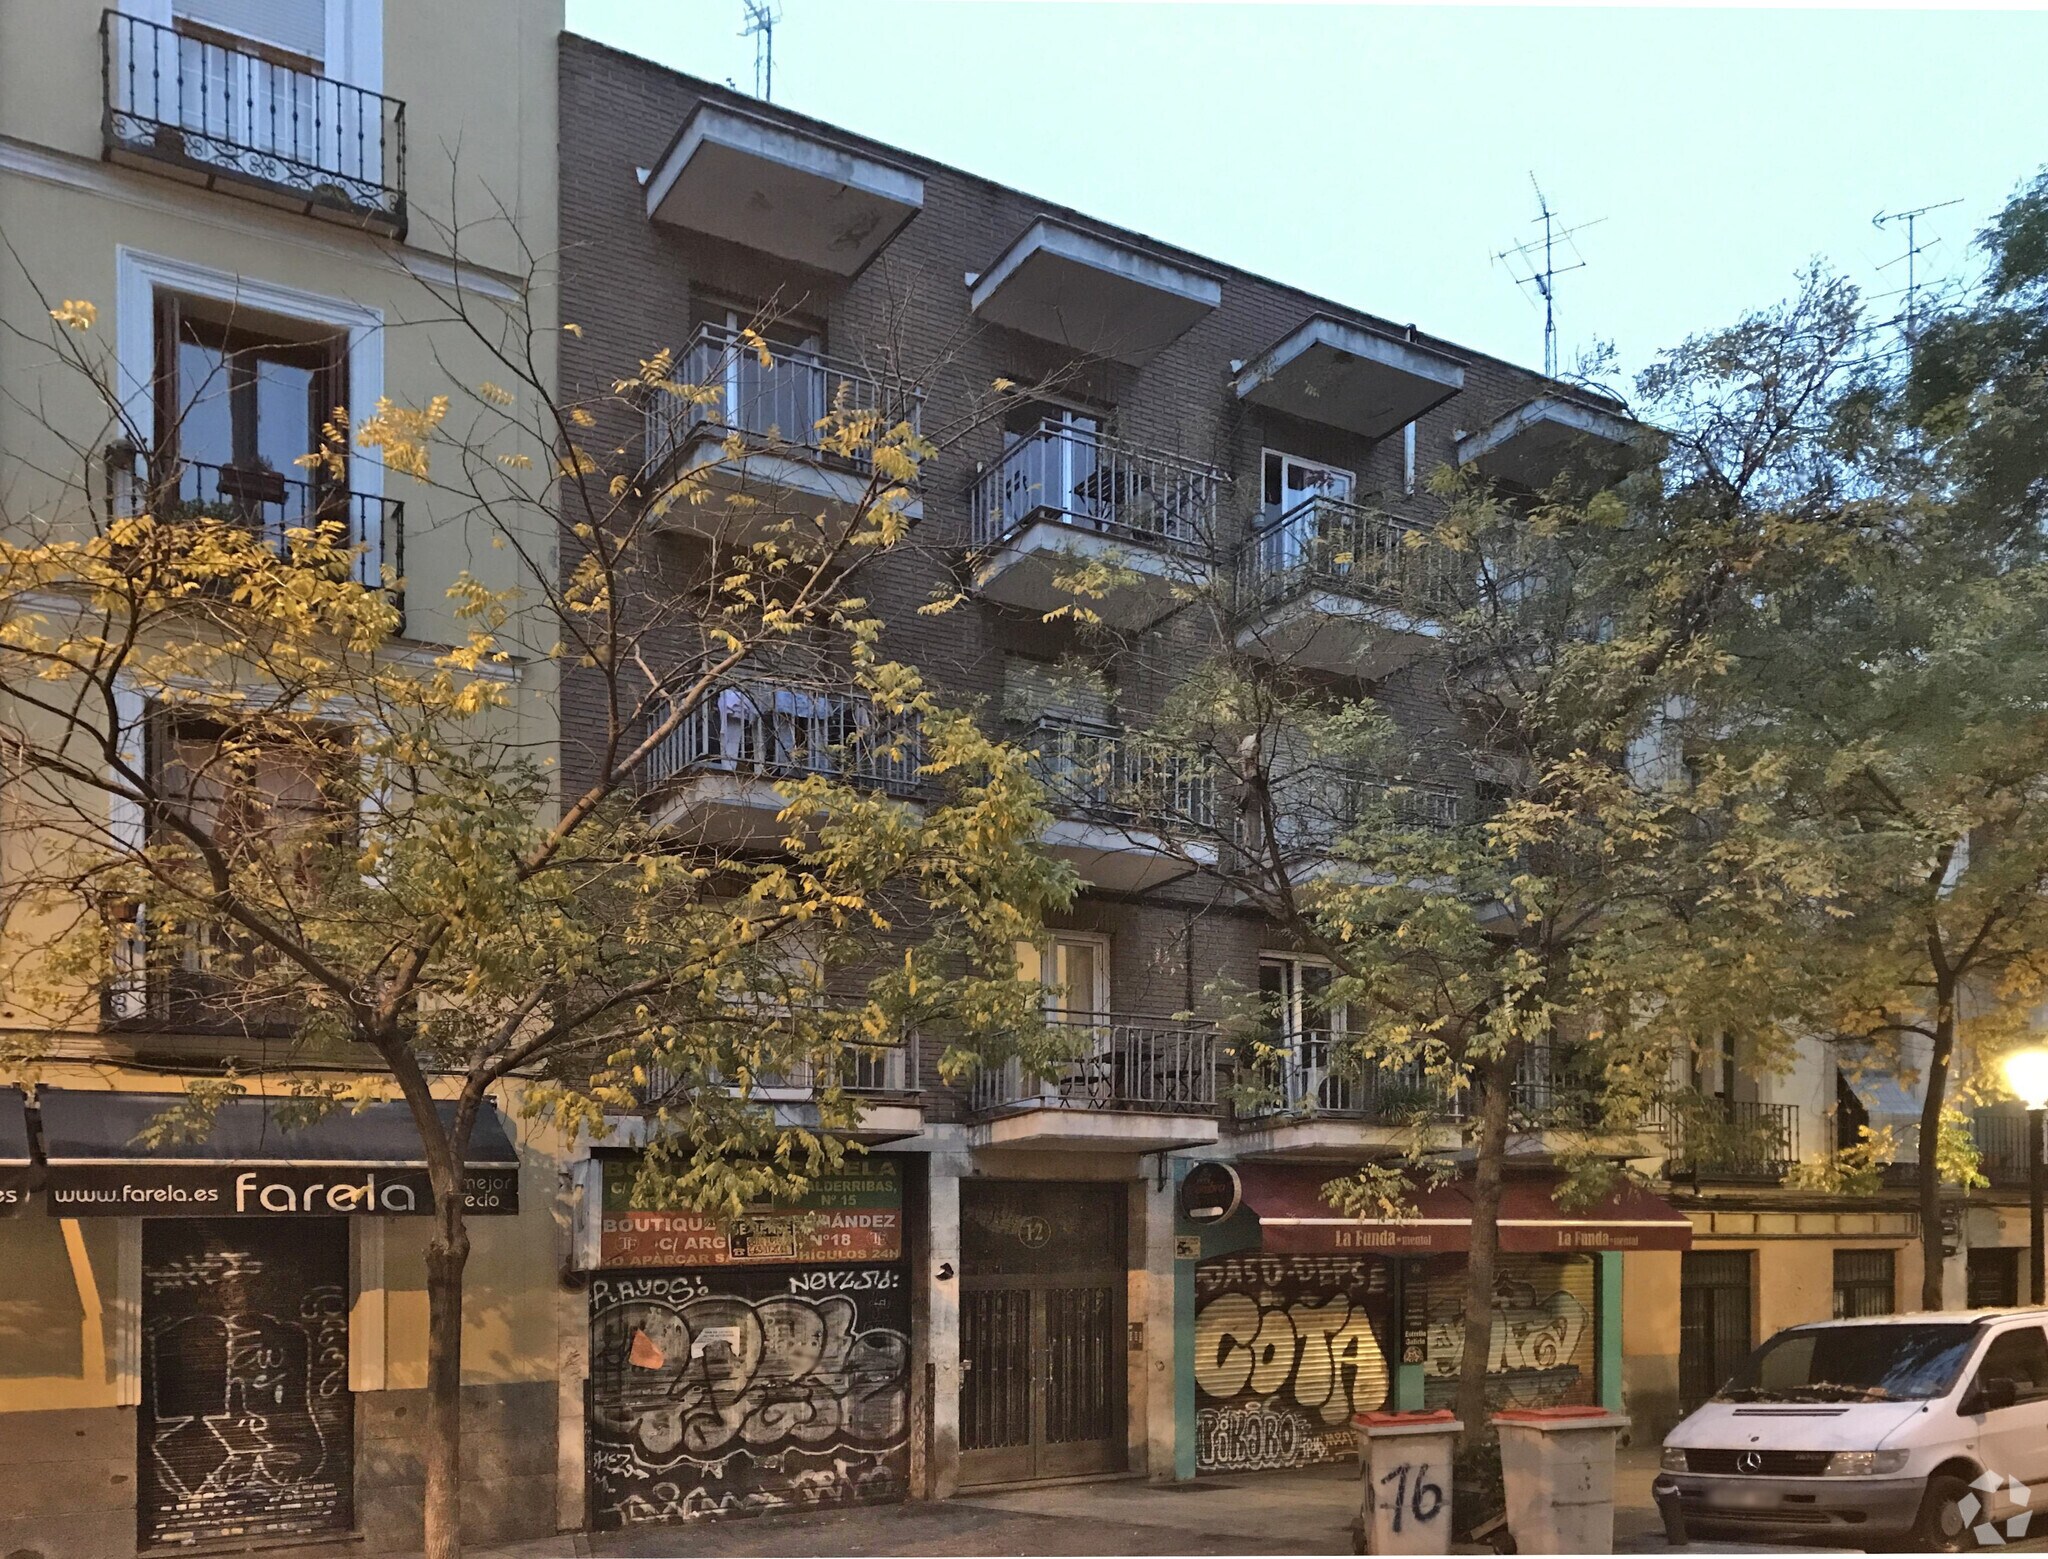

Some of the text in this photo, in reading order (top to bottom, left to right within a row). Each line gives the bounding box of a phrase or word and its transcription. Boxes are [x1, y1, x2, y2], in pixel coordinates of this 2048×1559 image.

[54, 1172, 415, 1212] www.farela.es farela
[806, 1180, 898, 1194] ALDERRIBAS,
[464, 1193, 499, 1207] ecio
[841, 1195, 857, 1206] 15
[1026, 1222, 1044, 1241] 12
[1335, 1230, 1352, 1247] La
[1557, 1230, 1572, 1247] La
[799, 1249, 868, 1261] HÍCULOS
